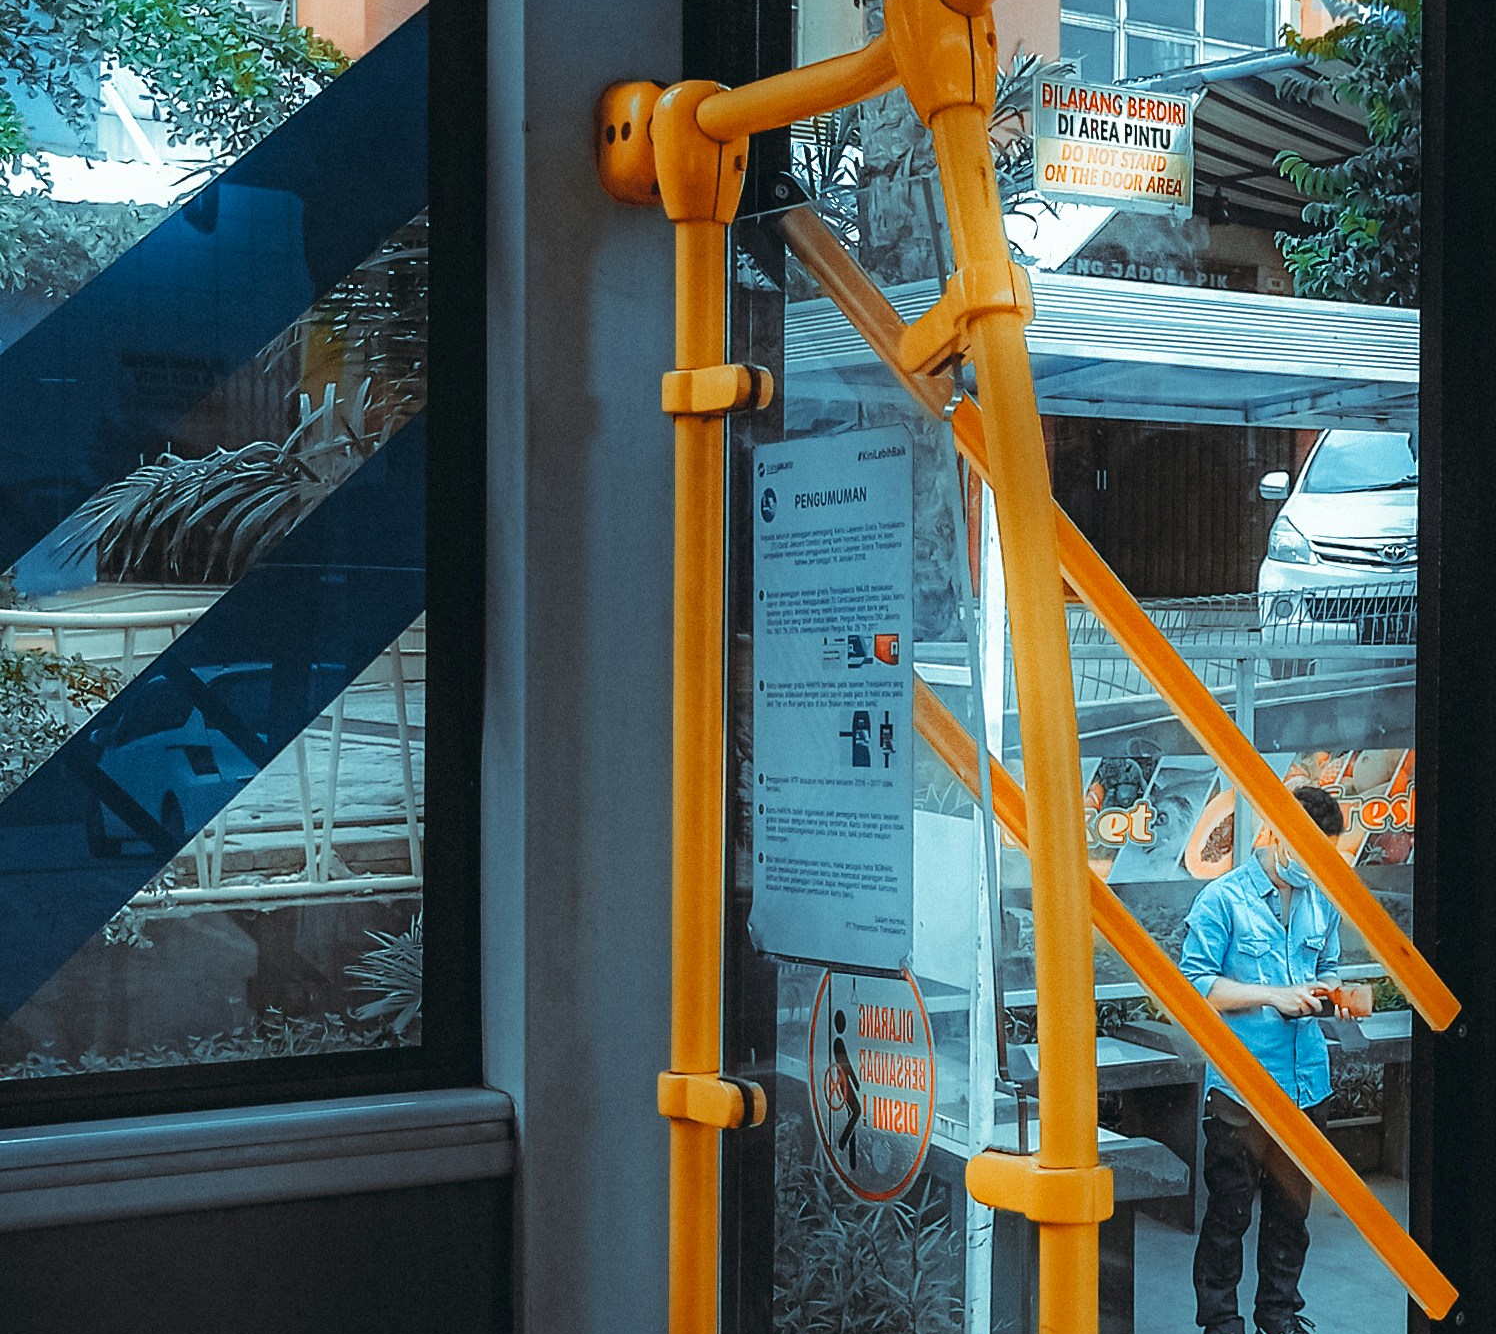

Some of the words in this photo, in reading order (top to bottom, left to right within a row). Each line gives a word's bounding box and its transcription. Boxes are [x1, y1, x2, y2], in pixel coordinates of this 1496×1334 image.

[1042, 82, 1123, 117] DILARANG
[1127, 96, 1186, 126] BERDIRI
[1058, 113, 1074, 136] DI
[1078, 117, 1120, 144] AREA
[1124, 123, 1171, 150] PINTU
[1061, 143, 1084, 162] DO
[1087, 146, 1119, 167] NOT
[1121, 153, 1167, 173] STAND
[1044, 164, 1067, 182] ON
[1071, 166, 1097, 186] THE
[1101, 170, 1143, 192] DOOR
[1146, 176, 1182, 197] AREA
[795, 487, 867, 509] PENGUMUMAN
